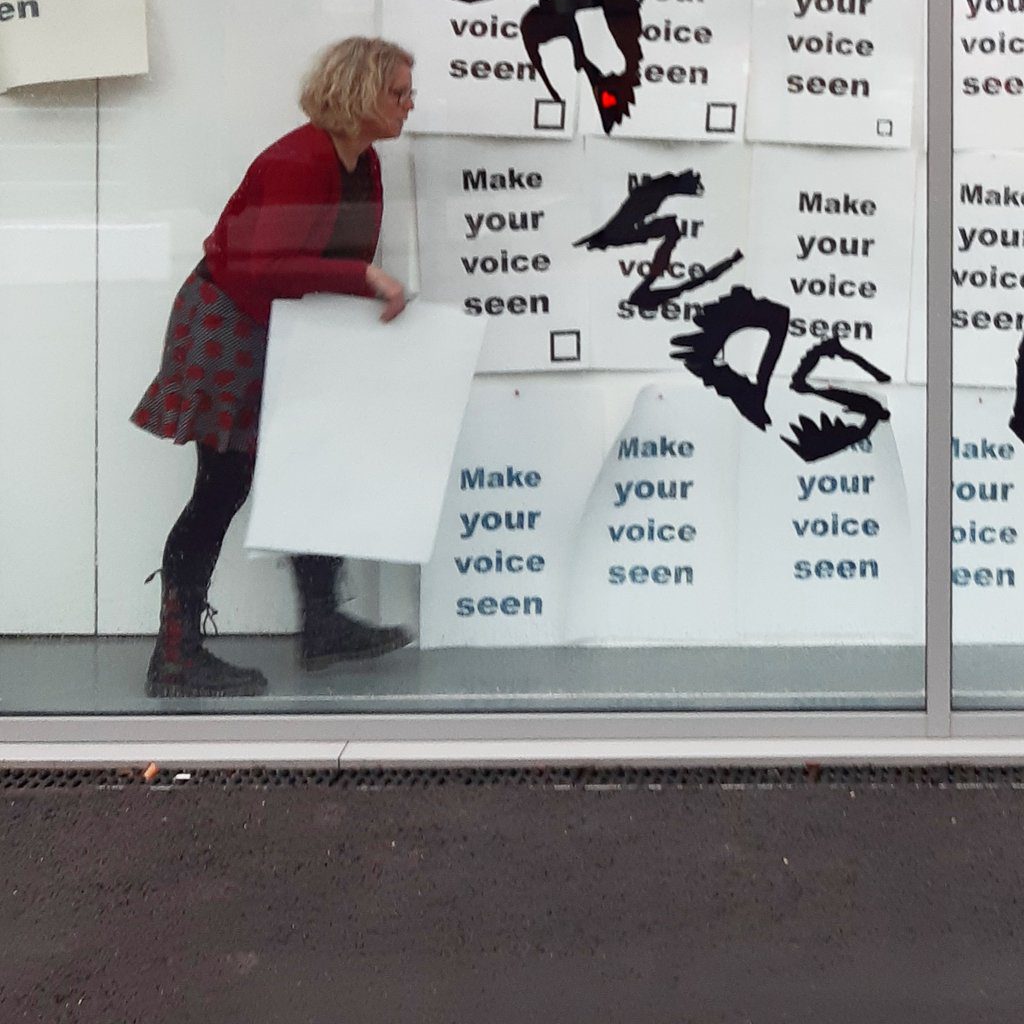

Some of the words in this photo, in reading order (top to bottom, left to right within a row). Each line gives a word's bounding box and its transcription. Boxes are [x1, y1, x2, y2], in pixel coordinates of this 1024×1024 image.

[451, 16, 521, 39] voic
[642, 18, 713, 44] oice
[787, 32, 874, 57] voice
[449, 59, 537, 81] seen
[643, 63, 709, 84] een
[786, 74, 871, 97] seen
[462, 168, 543, 192] Make
[799, 191, 877, 216] Make
[464, 211, 545, 240] your
[797, 235, 875, 260] your
[460, 250, 551, 275] voice
[790, 275, 877, 299] voice
[463, 293, 550, 316] seen
[788, 318, 874, 340] seen
[617, 436, 695, 461] Make
[460, 466, 542, 491] Make
[798, 474, 875, 501] your
[613, 478, 693, 507] your
[951, 480, 1014, 502] our
[459, 510, 541, 540] your
[608, 519, 697, 543] voice
[793, 514, 880, 537] voice
[951, 521, 1018, 545] oice
[454, 549, 545, 574] voice
[794, 558, 879, 580] seen
[608, 564, 694, 585] seen
[951, 566, 1016, 587] een
[456, 595, 543, 617] seen
